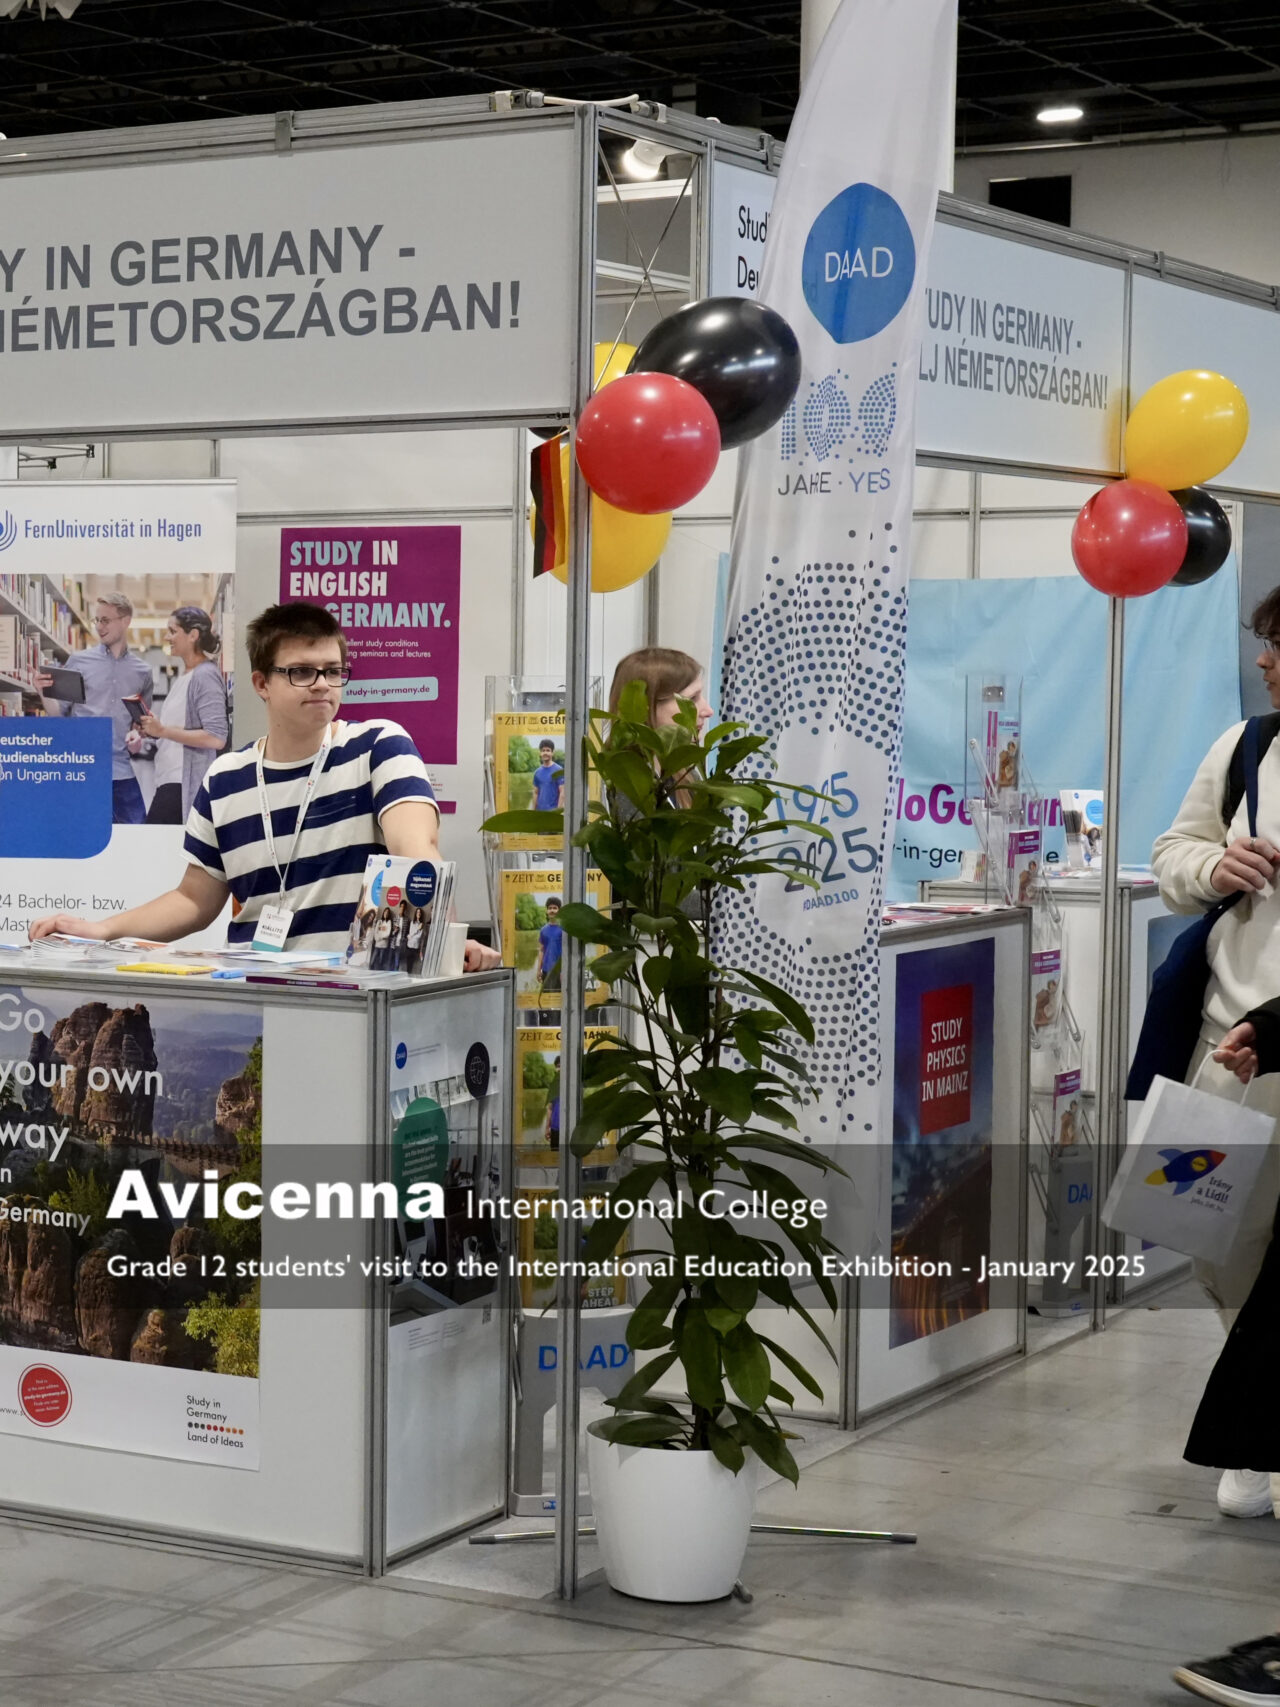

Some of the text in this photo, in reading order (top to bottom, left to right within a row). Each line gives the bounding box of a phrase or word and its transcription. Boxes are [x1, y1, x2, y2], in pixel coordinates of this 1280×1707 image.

[738, 205, 770, 243] Stud
[46, 244, 91, 290] IN
[111, 224, 384, 286] GERMANY
[825, 246, 894, 283] DAAD
[971, 297, 987, 338] IN
[993, 303, 1074, 356] GERMANY
[945, 338, 1108, 410] NÉMETORSZÁGBAN!
[24, 519, 202, 542] FernUniversität in Hagen
[289, 540, 398, 567] STUDY IN
[289, 571, 388, 597] ENGLISH
[366, 638, 383, 649] study
[391, 649, 404, 657] and
[346, 684, 431, 697] study-in-germany.de
[17, 768, 61, 785] Ungarn
[65, 771, 86, 782] aus
[512, 873, 535, 883] ZEIT
[18, 893, 86, 910] Bachelor-
[92, 893, 127, 912] bzw.
[519, 1031, 542, 1042] ZEIT
[931, 1017, 963, 1045] STUDY
[926, 1044, 966, 1073] PHYSICS
[87, 1066, 164, 1097] own
[922, 1070, 969, 1102] IN MAINZ
[1067, 1183, 1093, 1204] DA
[538, 1344, 629, 1370] DAD
[186, 1394, 221, 1410] Study in
[186, 1406, 228, 1424] Germany
[187, 1431, 244, 1449] Land of Ideas
